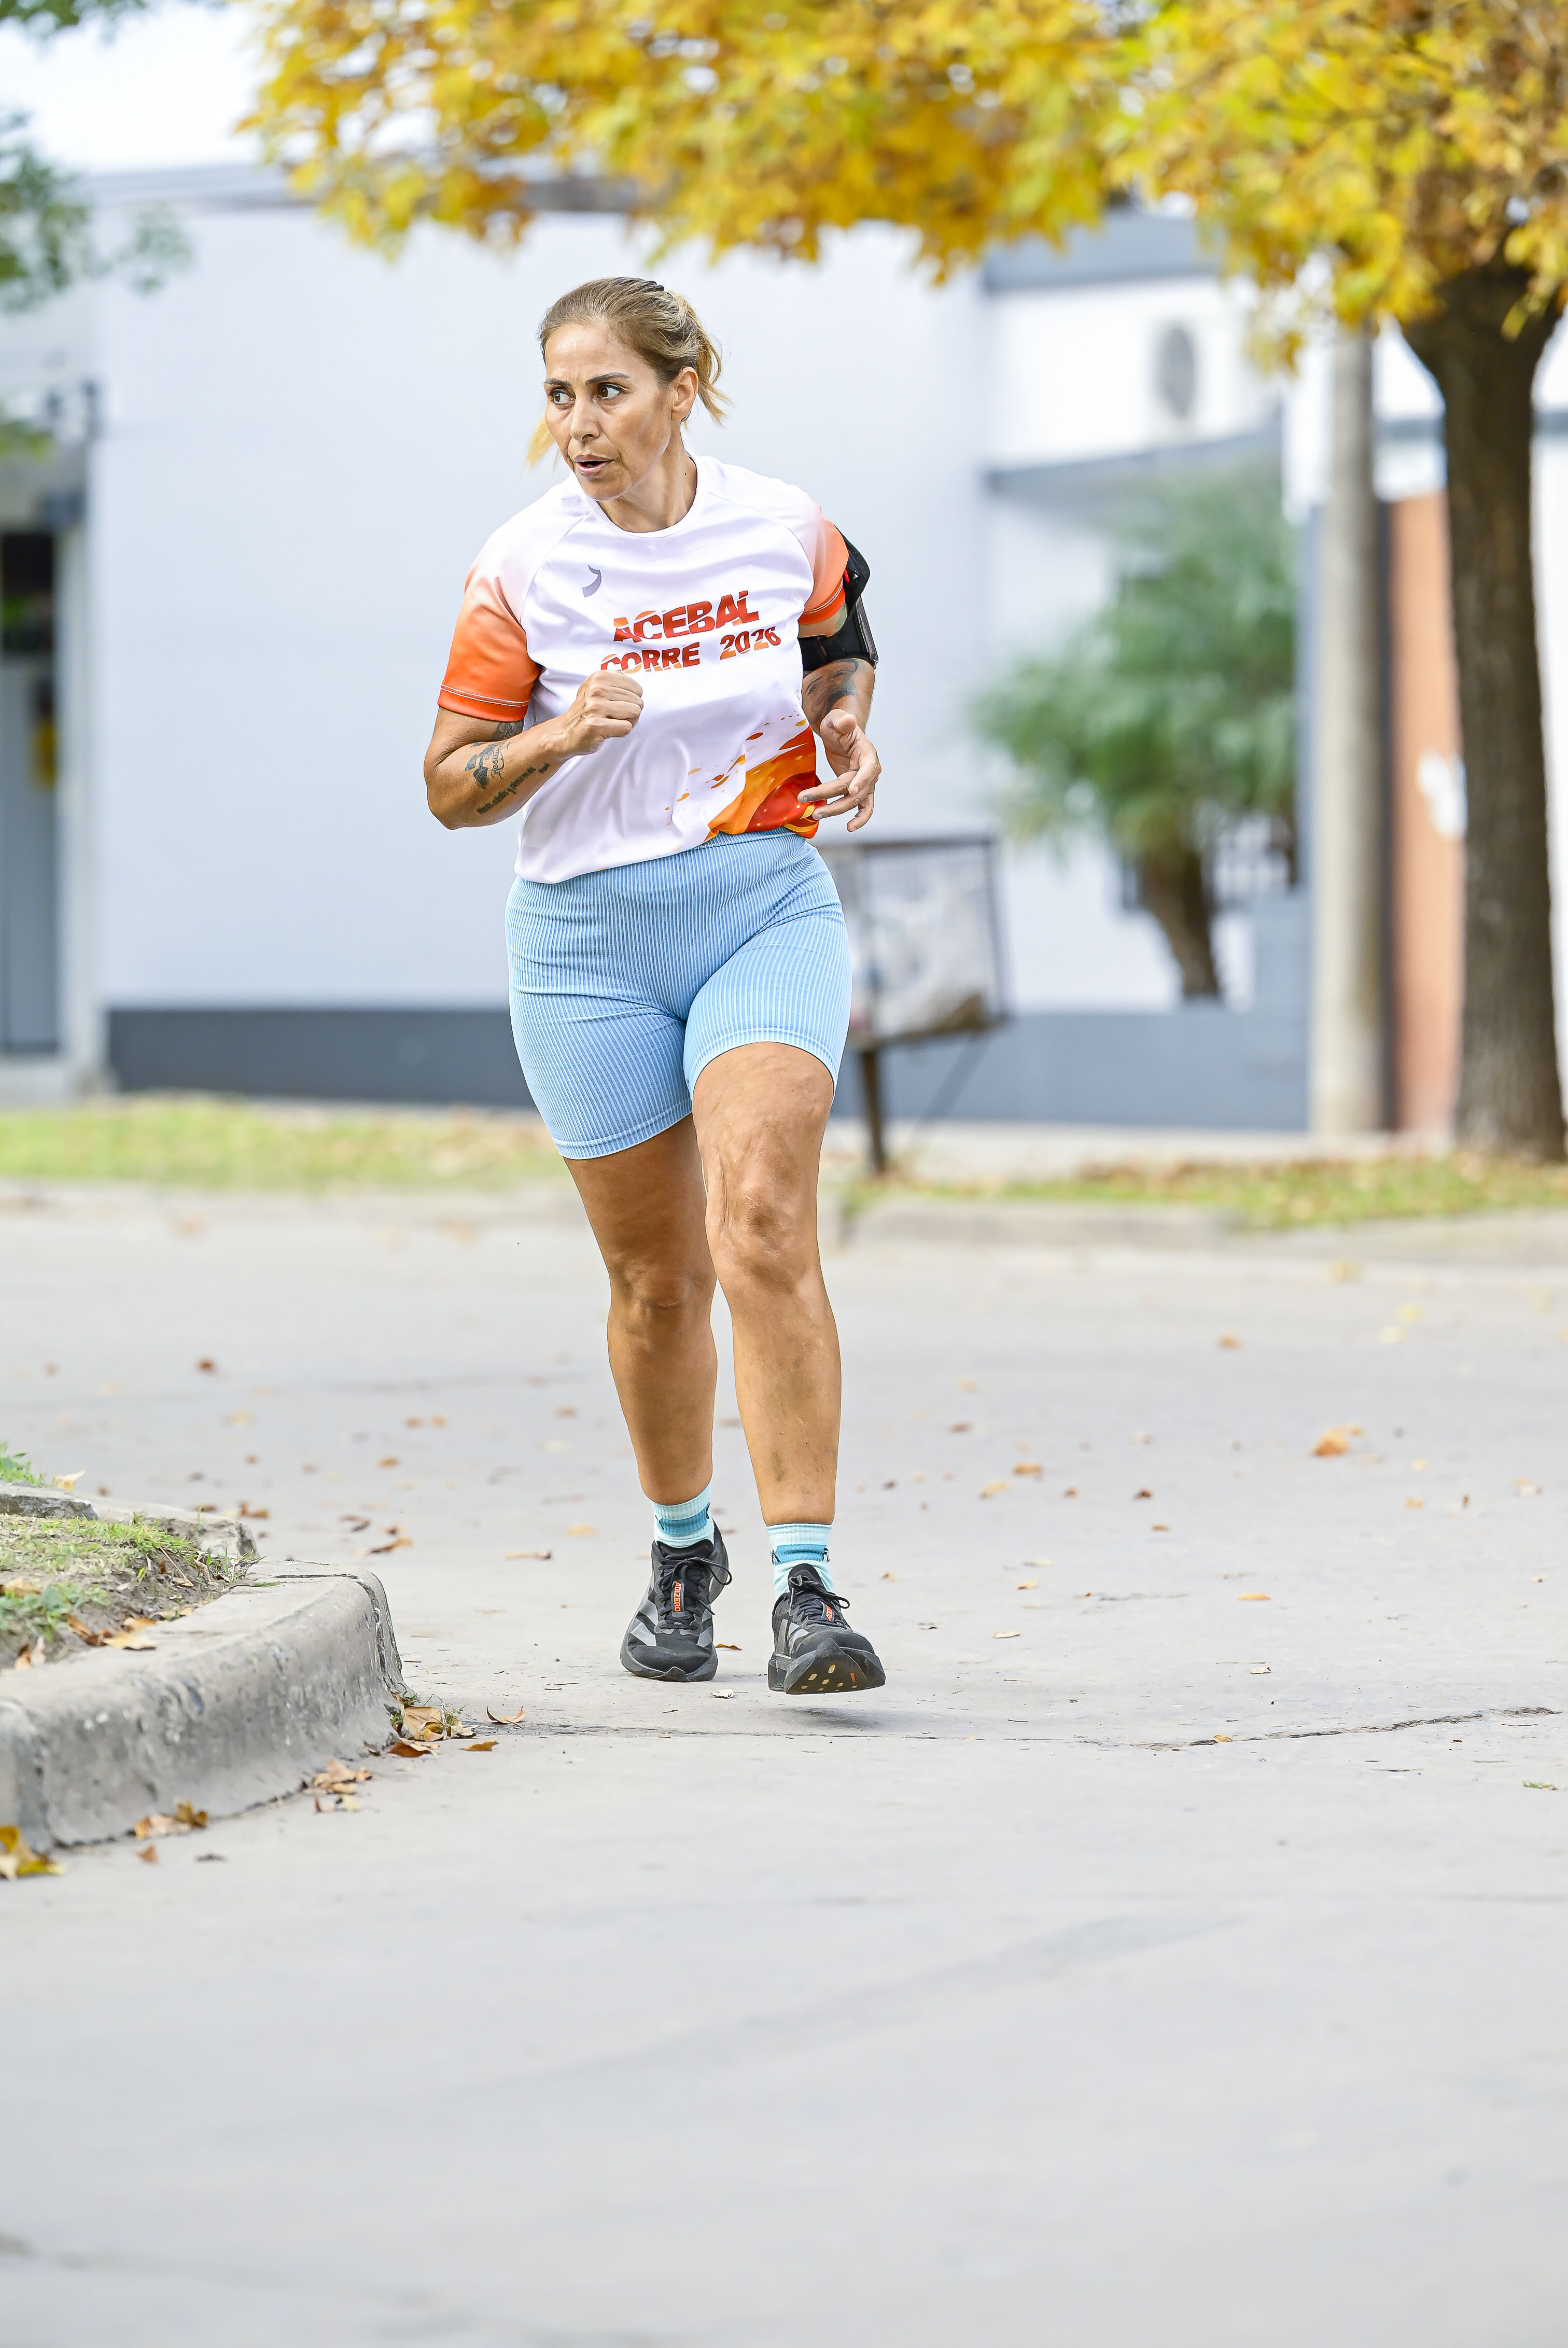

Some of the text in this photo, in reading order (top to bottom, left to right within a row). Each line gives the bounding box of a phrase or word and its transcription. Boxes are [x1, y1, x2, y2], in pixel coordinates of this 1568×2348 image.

[613, 590, 759, 642] ACEBAL
[600, 626, 781, 674] CORRE 2026
